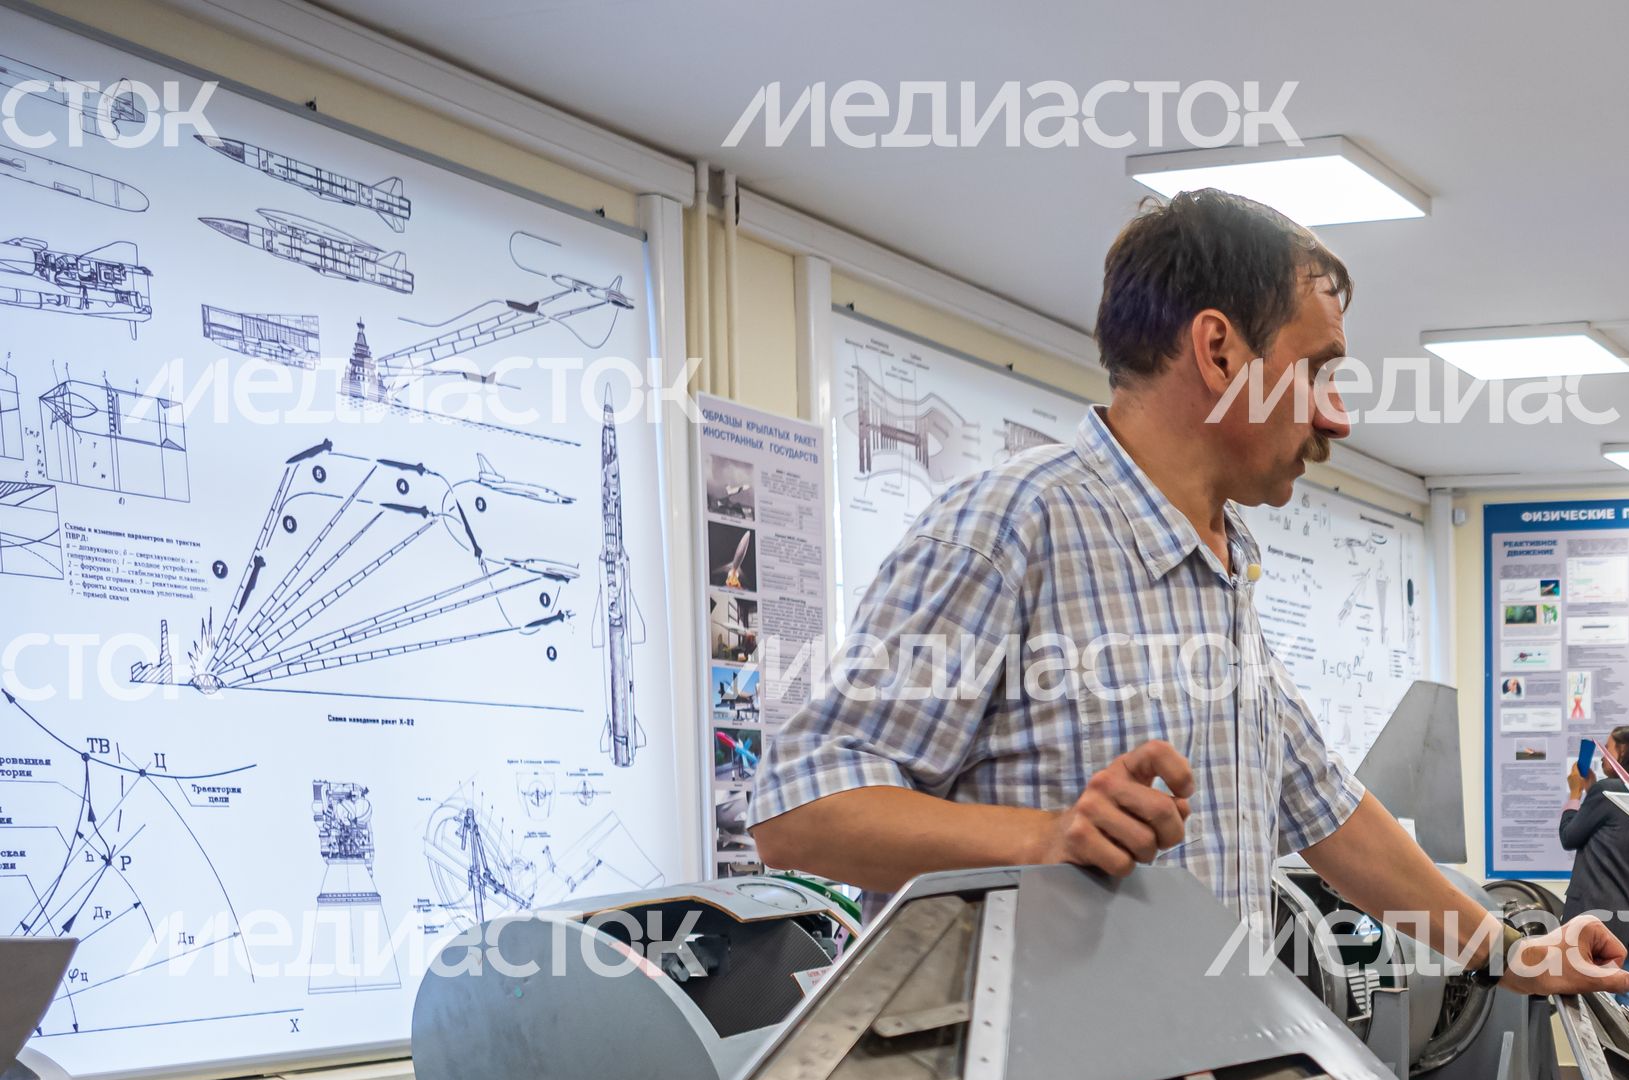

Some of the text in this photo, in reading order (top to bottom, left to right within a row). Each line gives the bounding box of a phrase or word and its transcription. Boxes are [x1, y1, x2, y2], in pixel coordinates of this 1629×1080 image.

[702, 408, 817, 448] ОБРАЗЦЫ КРЫЛАТЫХ РАКЕТ
[703, 427, 818, 464] ИНОСТРАННЫХ ГОСУДАРСТВ
[1521, 509, 1615, 522] ФИЗИЧЕСКИЕ
[154, 753, 167, 772] Ц
[191, 784, 242, 794] Траектория
[85, 851, 94, 862] h
